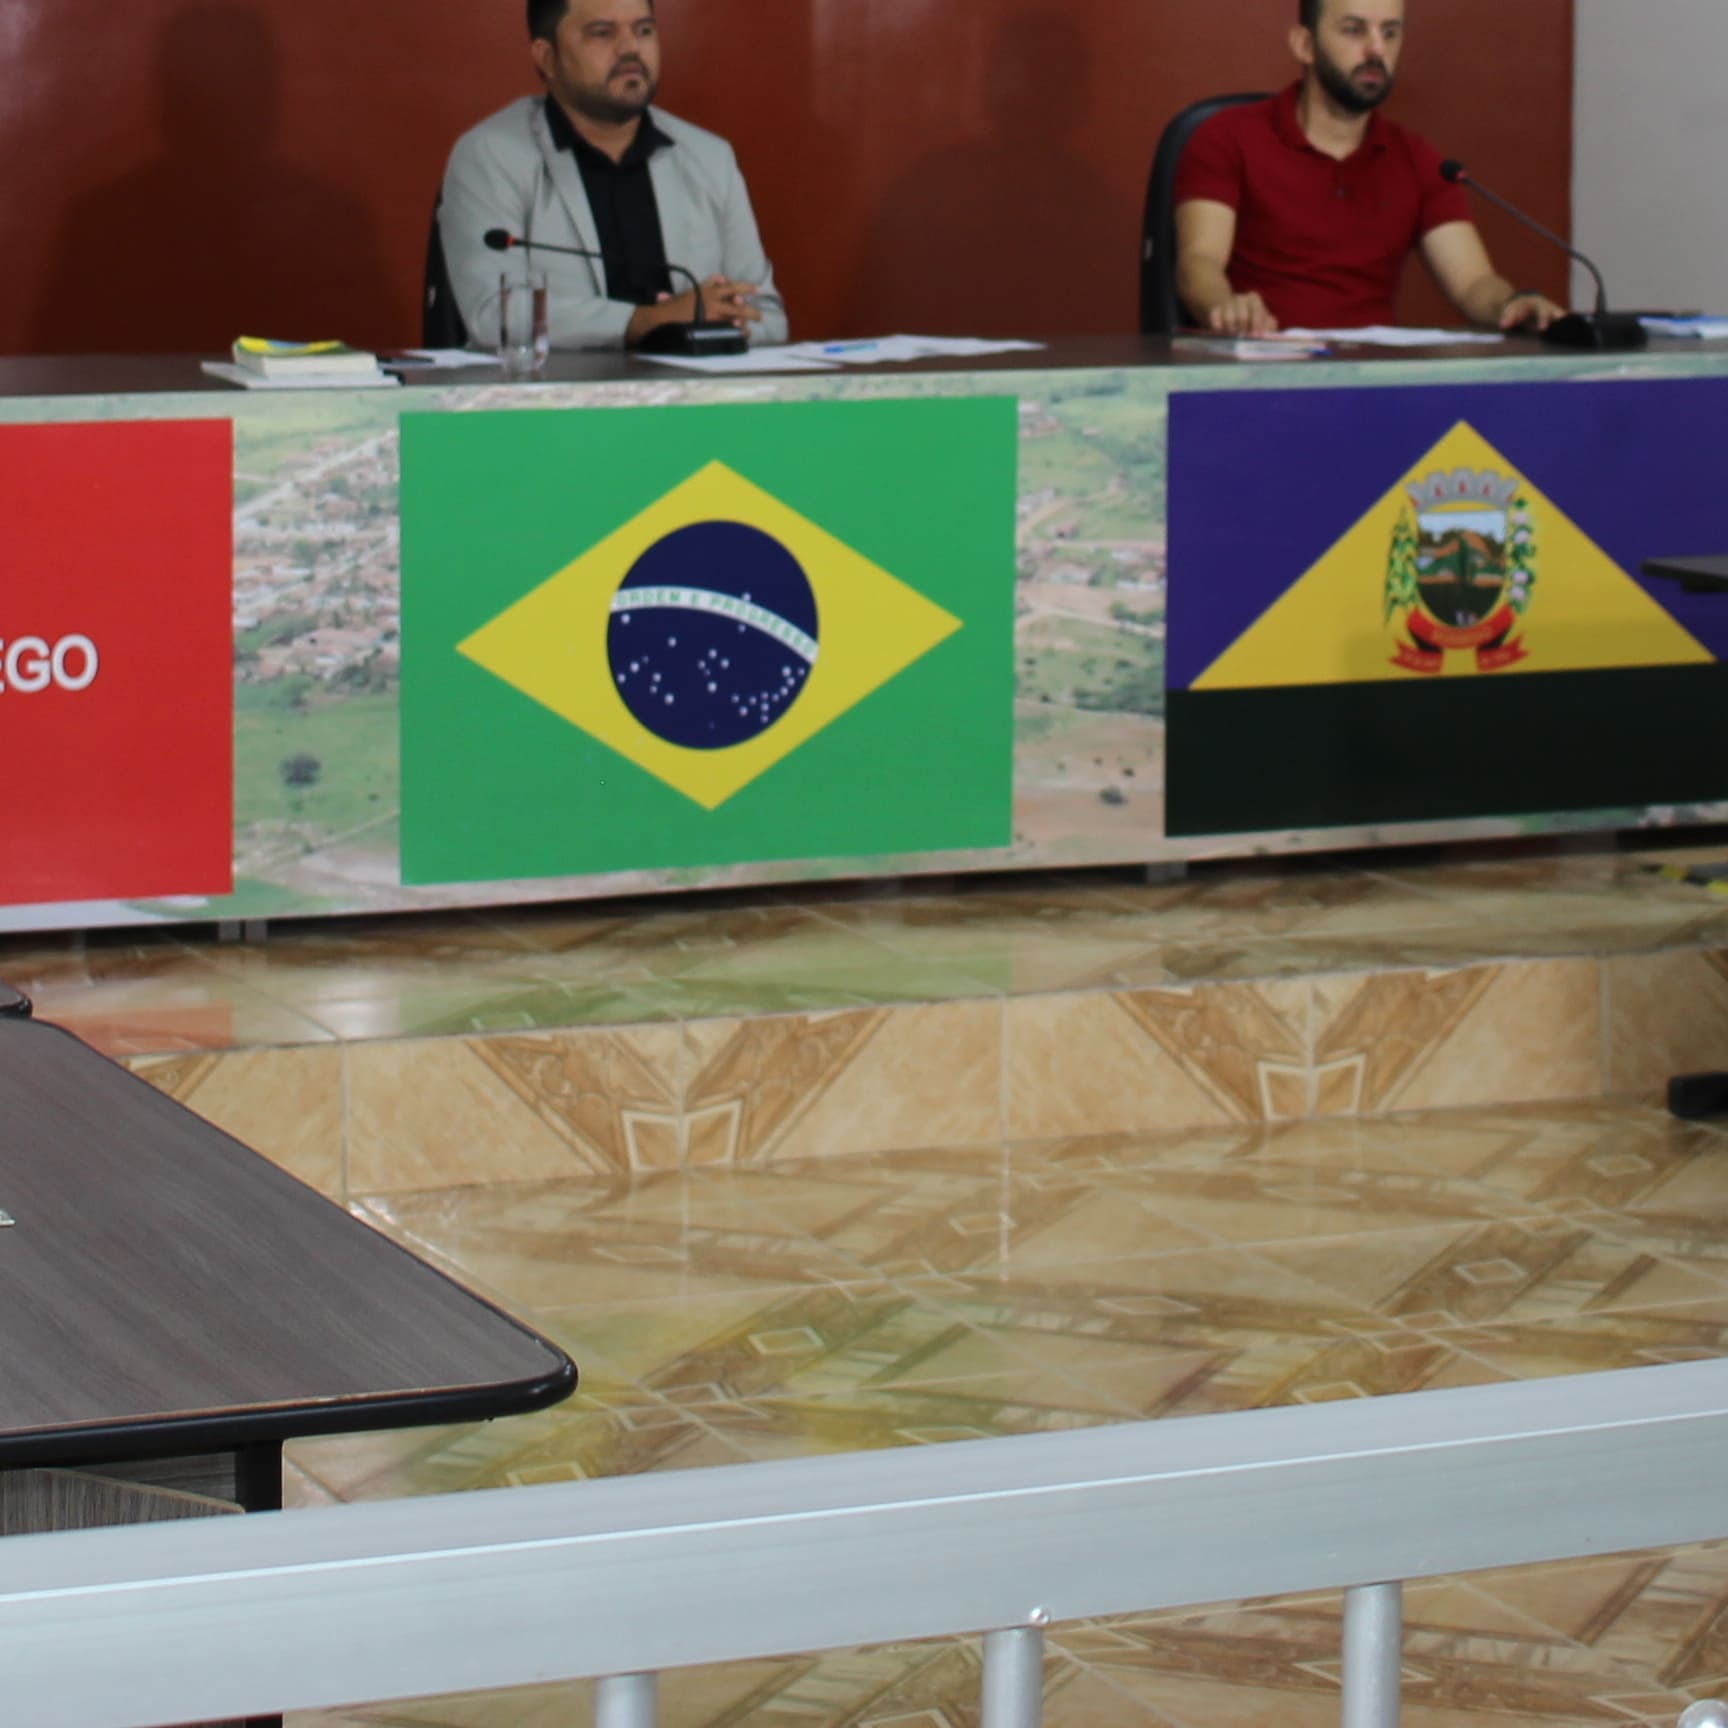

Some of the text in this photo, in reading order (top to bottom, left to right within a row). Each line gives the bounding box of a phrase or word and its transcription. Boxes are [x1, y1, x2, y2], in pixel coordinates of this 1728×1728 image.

[615, 587, 816, 657] ORDEM E PROGRESSO
